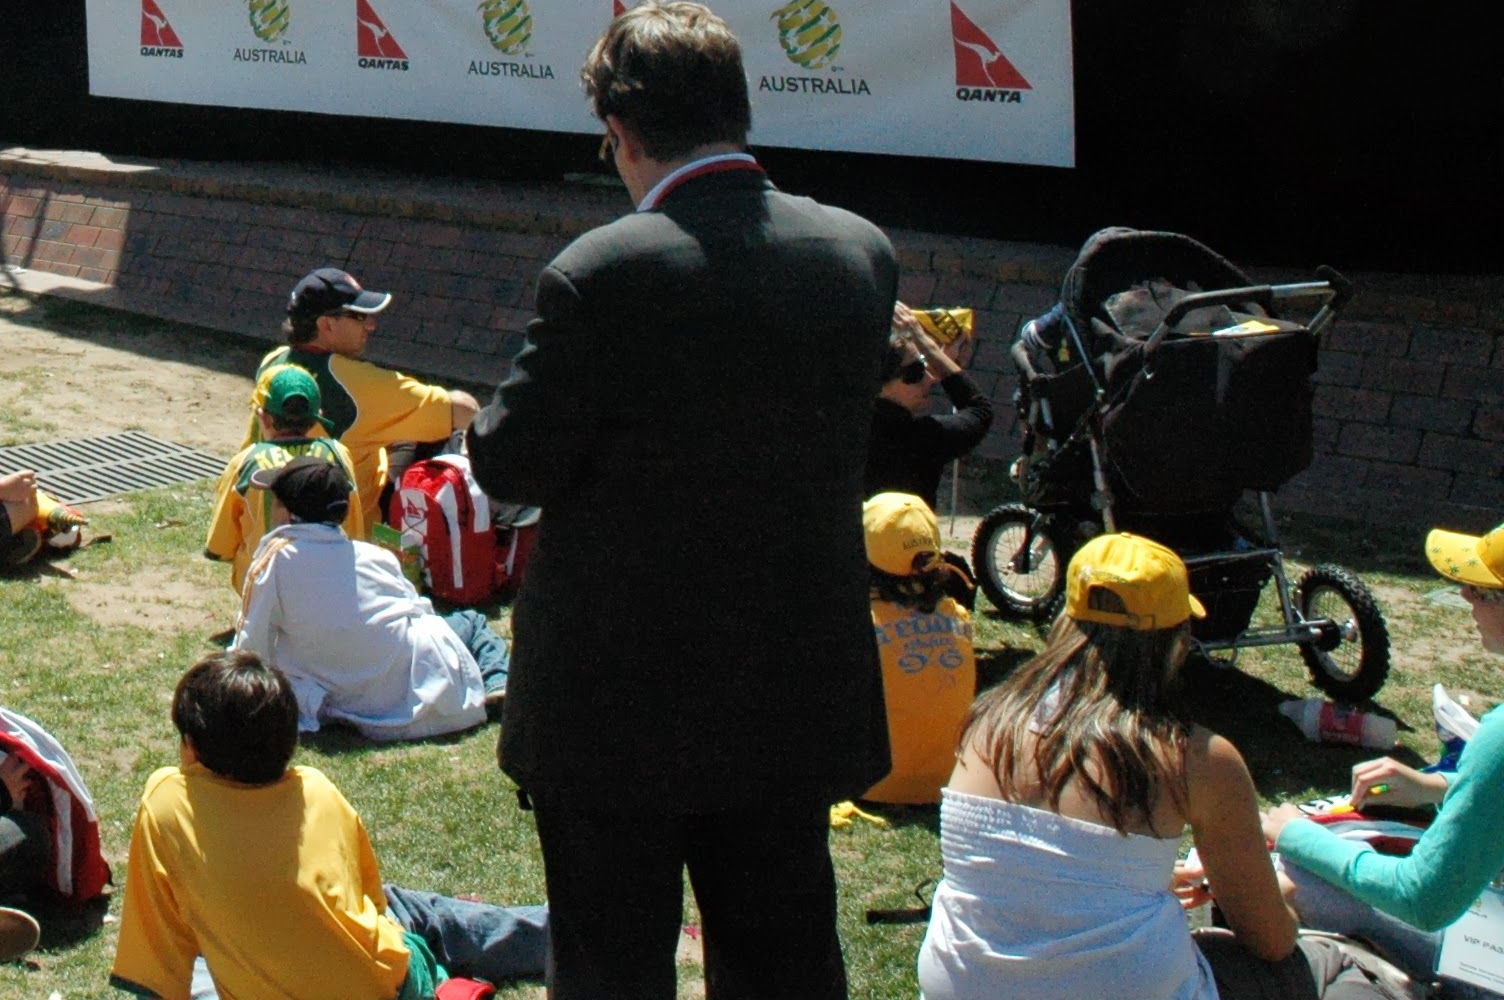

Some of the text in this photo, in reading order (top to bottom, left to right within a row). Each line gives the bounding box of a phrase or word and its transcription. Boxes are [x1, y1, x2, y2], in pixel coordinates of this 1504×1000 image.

[140, 46, 184, 59] QANTAS
[233, 48, 307, 65] AUSTRALIA
[358, 58, 409, 71] QANTAS
[467, 60, 555, 80] AUSTRALIA
[759, 75, 871, 96] AUSTRALIA
